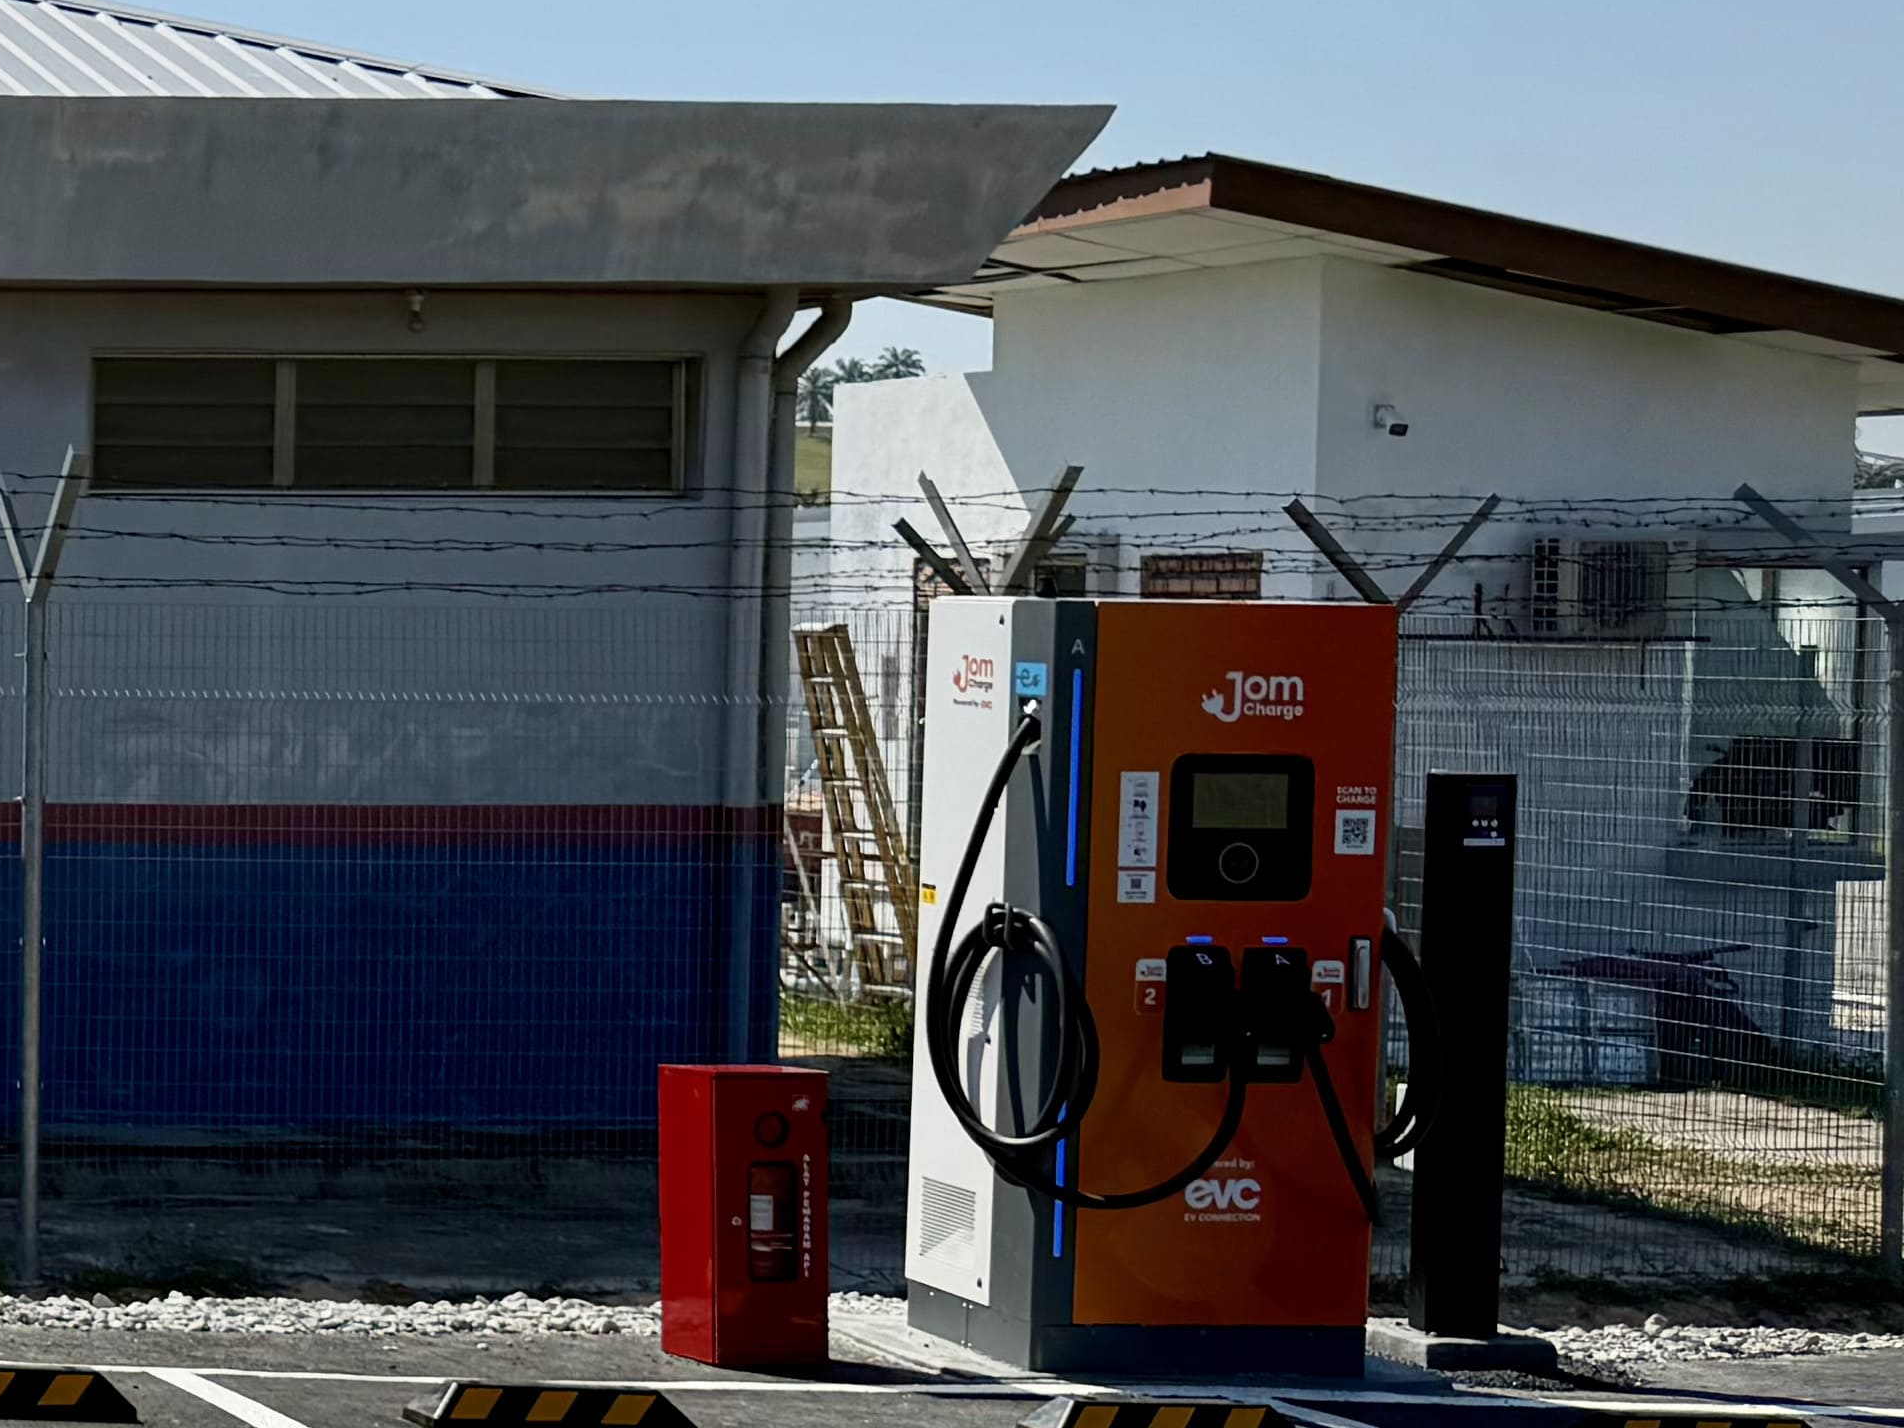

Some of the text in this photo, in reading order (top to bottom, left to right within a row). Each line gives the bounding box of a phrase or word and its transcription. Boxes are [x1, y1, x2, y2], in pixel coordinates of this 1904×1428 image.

[1071, 638, 1085, 655] A
[953, 654, 994, 693] Jom
[1201, 671, 1304, 723] Jom
[1243, 702, 1304, 720] Charge
[1336, 786, 1377, 795] SCAN TO
[1336, 795, 1376, 805] CHARGE
[1196, 953, 1213, 965] B
[1275, 954, 1290, 965] A
[1144, 988, 1156, 1005] 2
